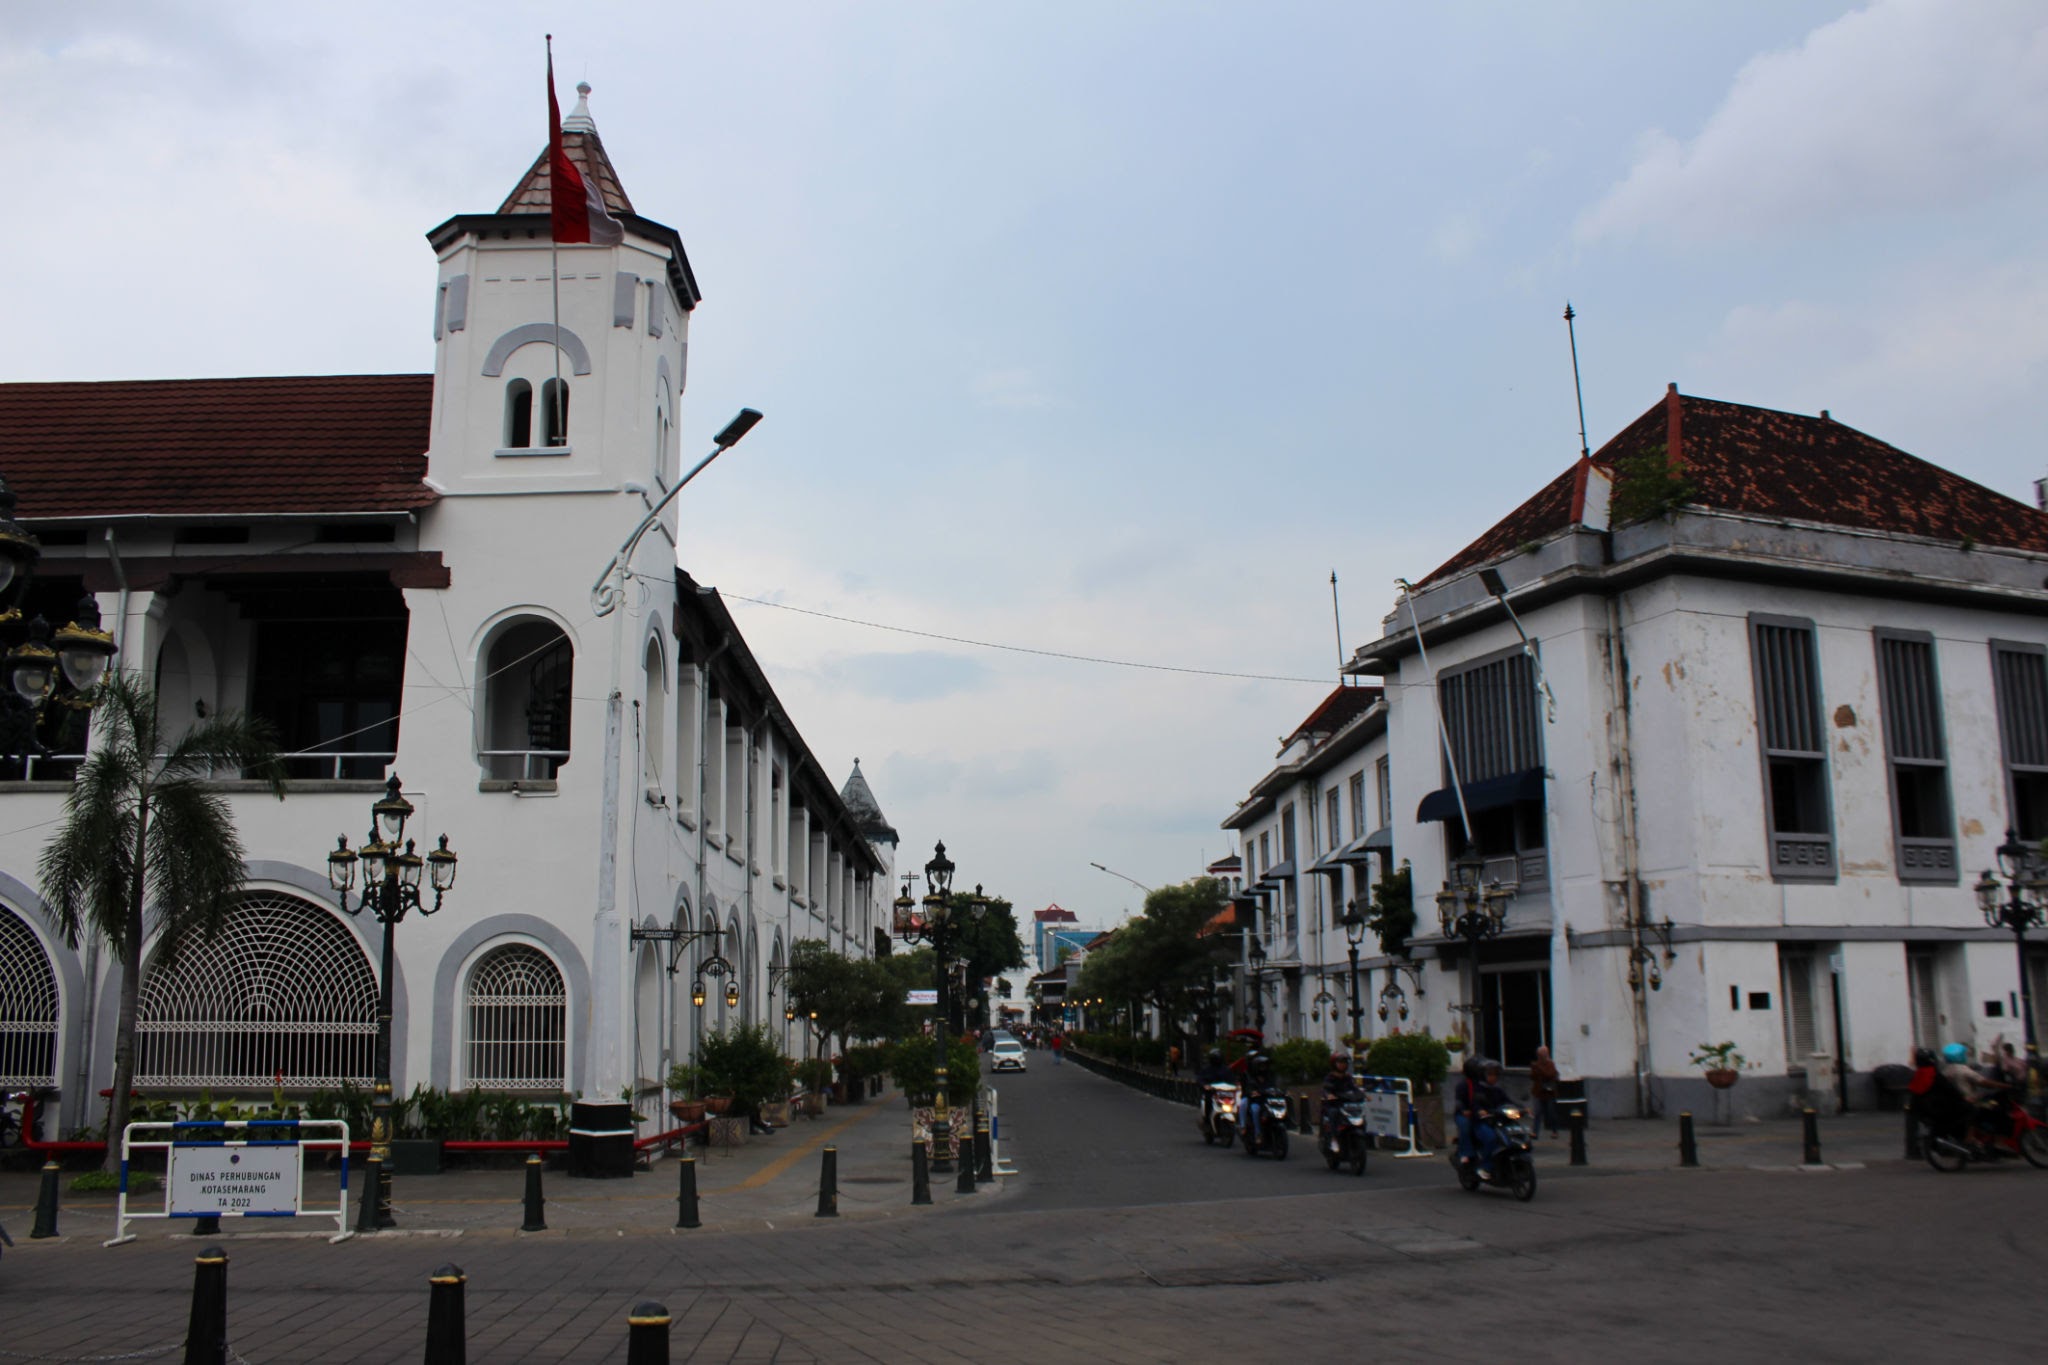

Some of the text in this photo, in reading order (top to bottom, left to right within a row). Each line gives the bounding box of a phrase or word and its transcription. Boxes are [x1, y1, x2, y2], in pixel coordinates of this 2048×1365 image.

[190, 1171, 281, 1182] DINAS PERHUBUNGAN
[218, 1198, 251, 1207] TA 2022
